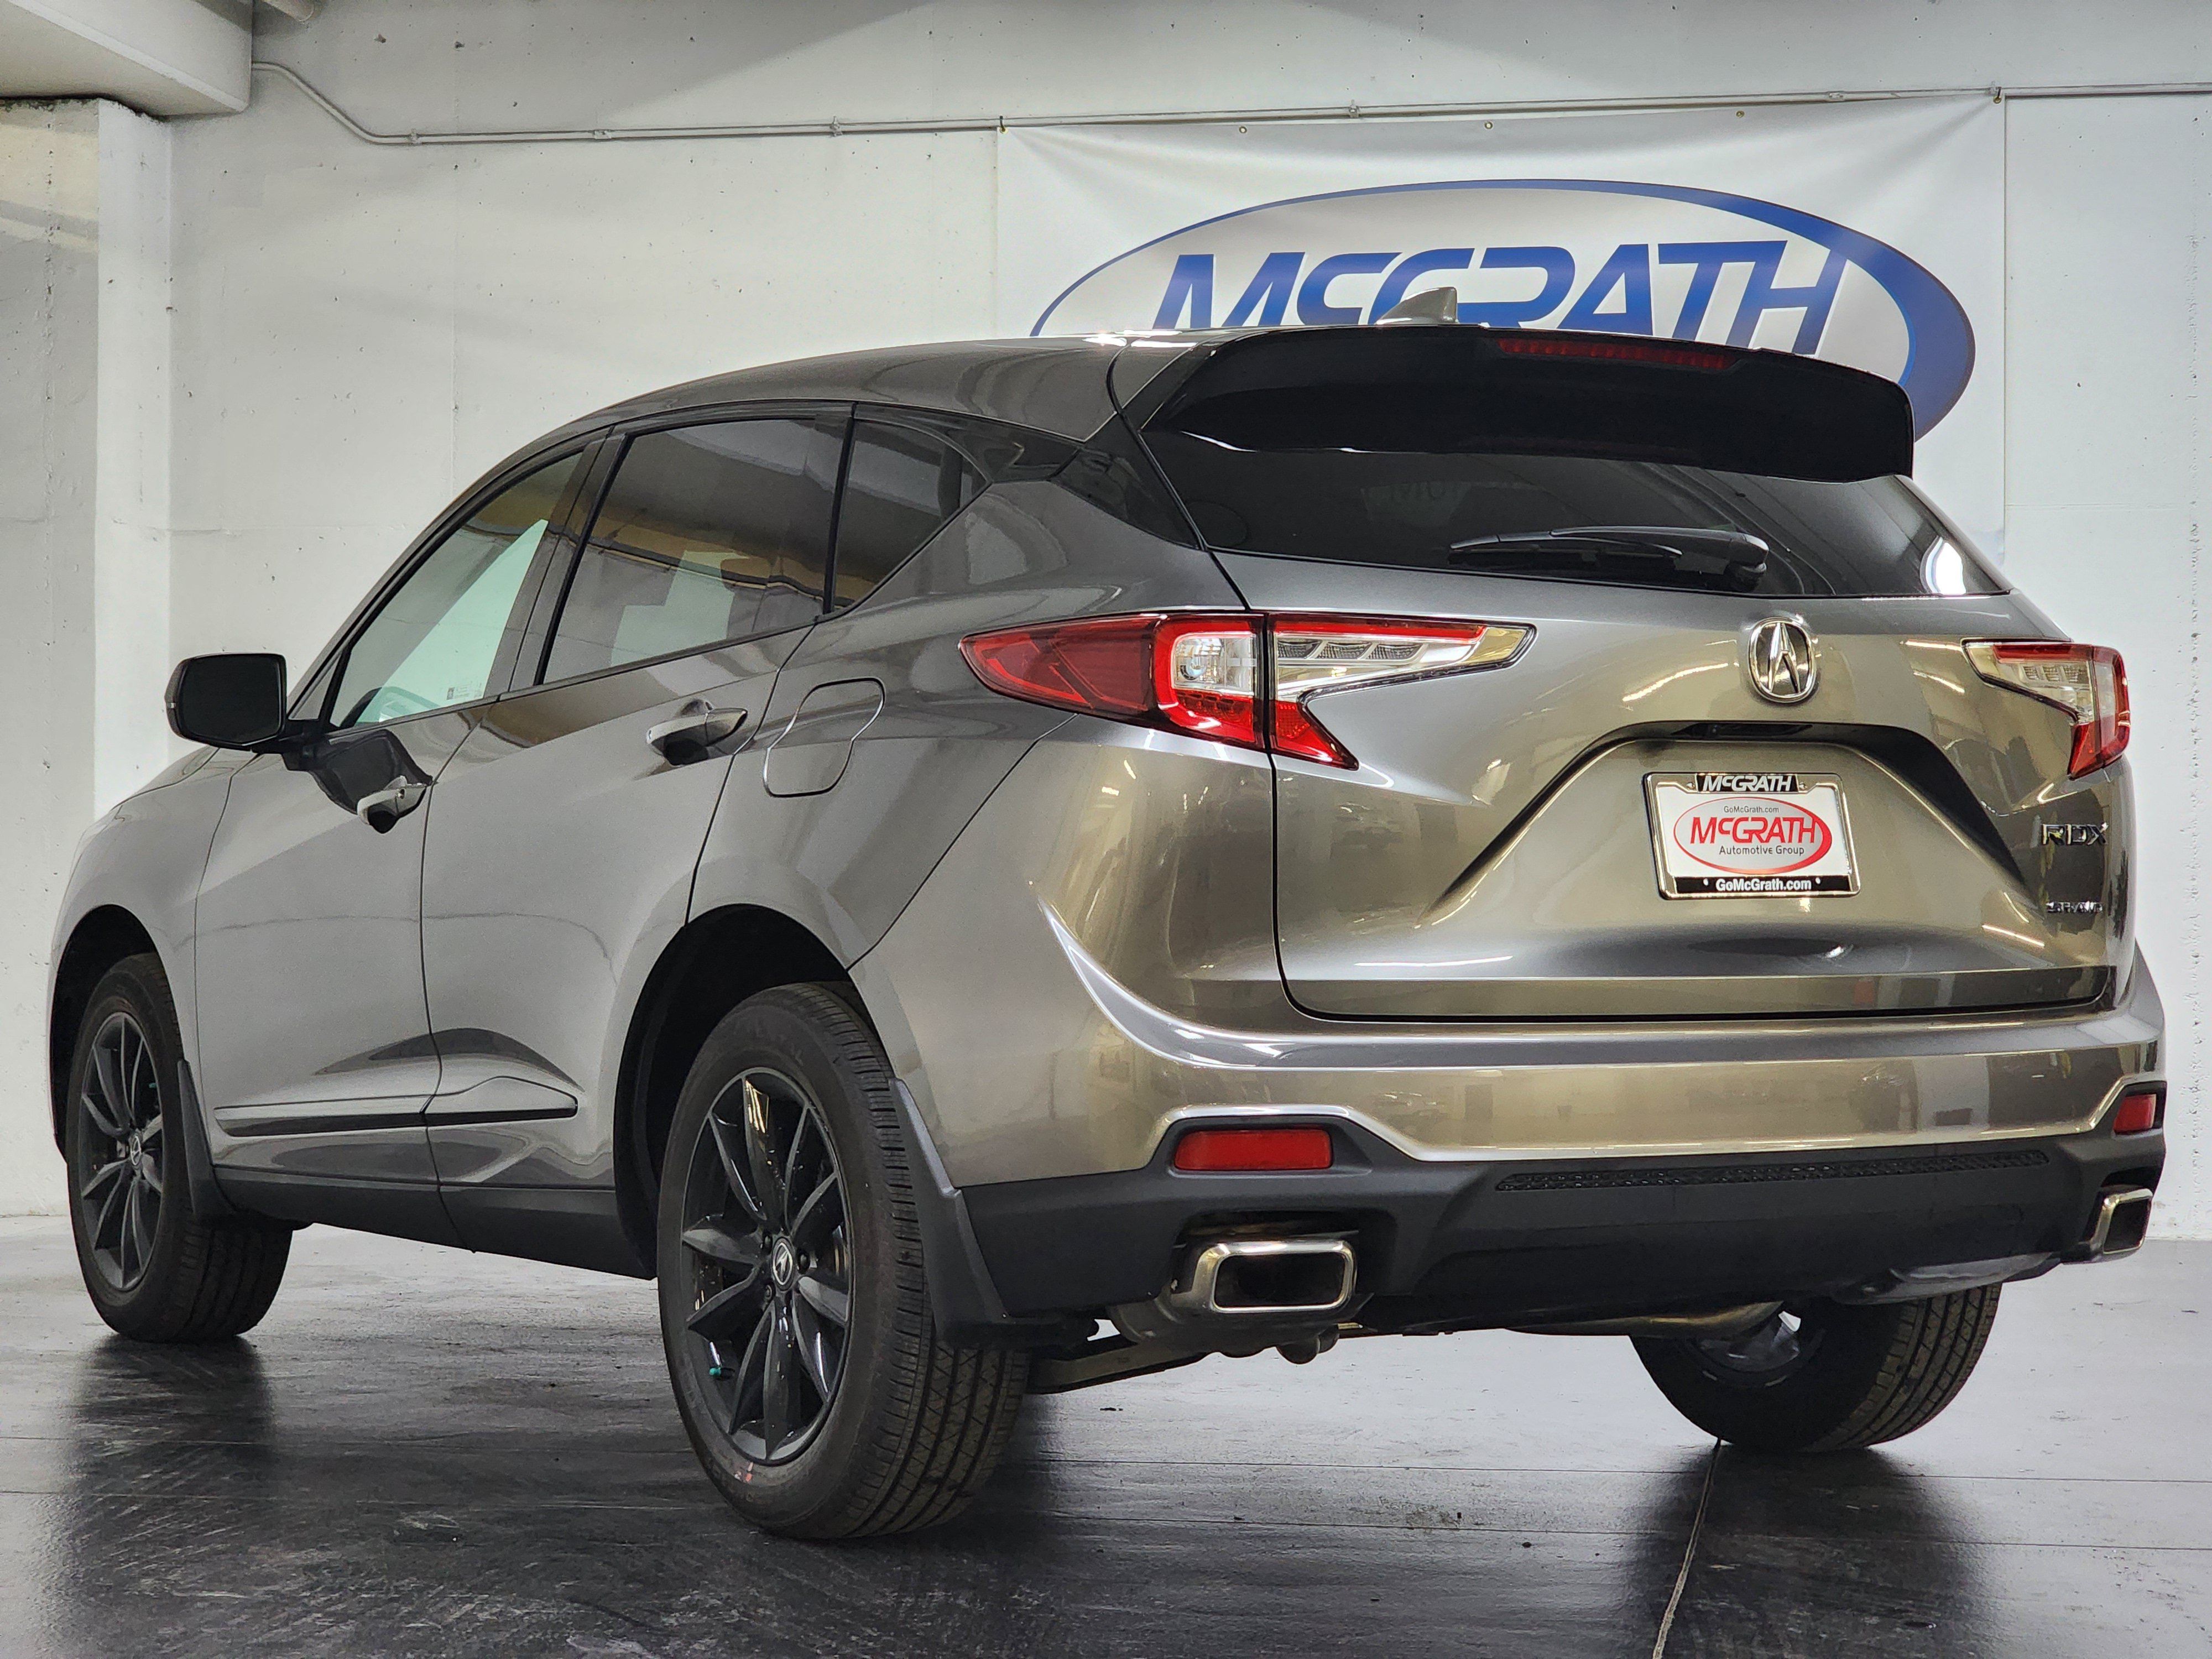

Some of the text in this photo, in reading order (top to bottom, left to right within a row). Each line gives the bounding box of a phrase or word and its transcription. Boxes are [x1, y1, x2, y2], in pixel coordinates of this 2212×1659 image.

[2041, 823, 2108, 846] RDX
[1719, 845, 1804, 856] Automotive Group
[1715, 878, 1812, 891] GoMcGrath.com
